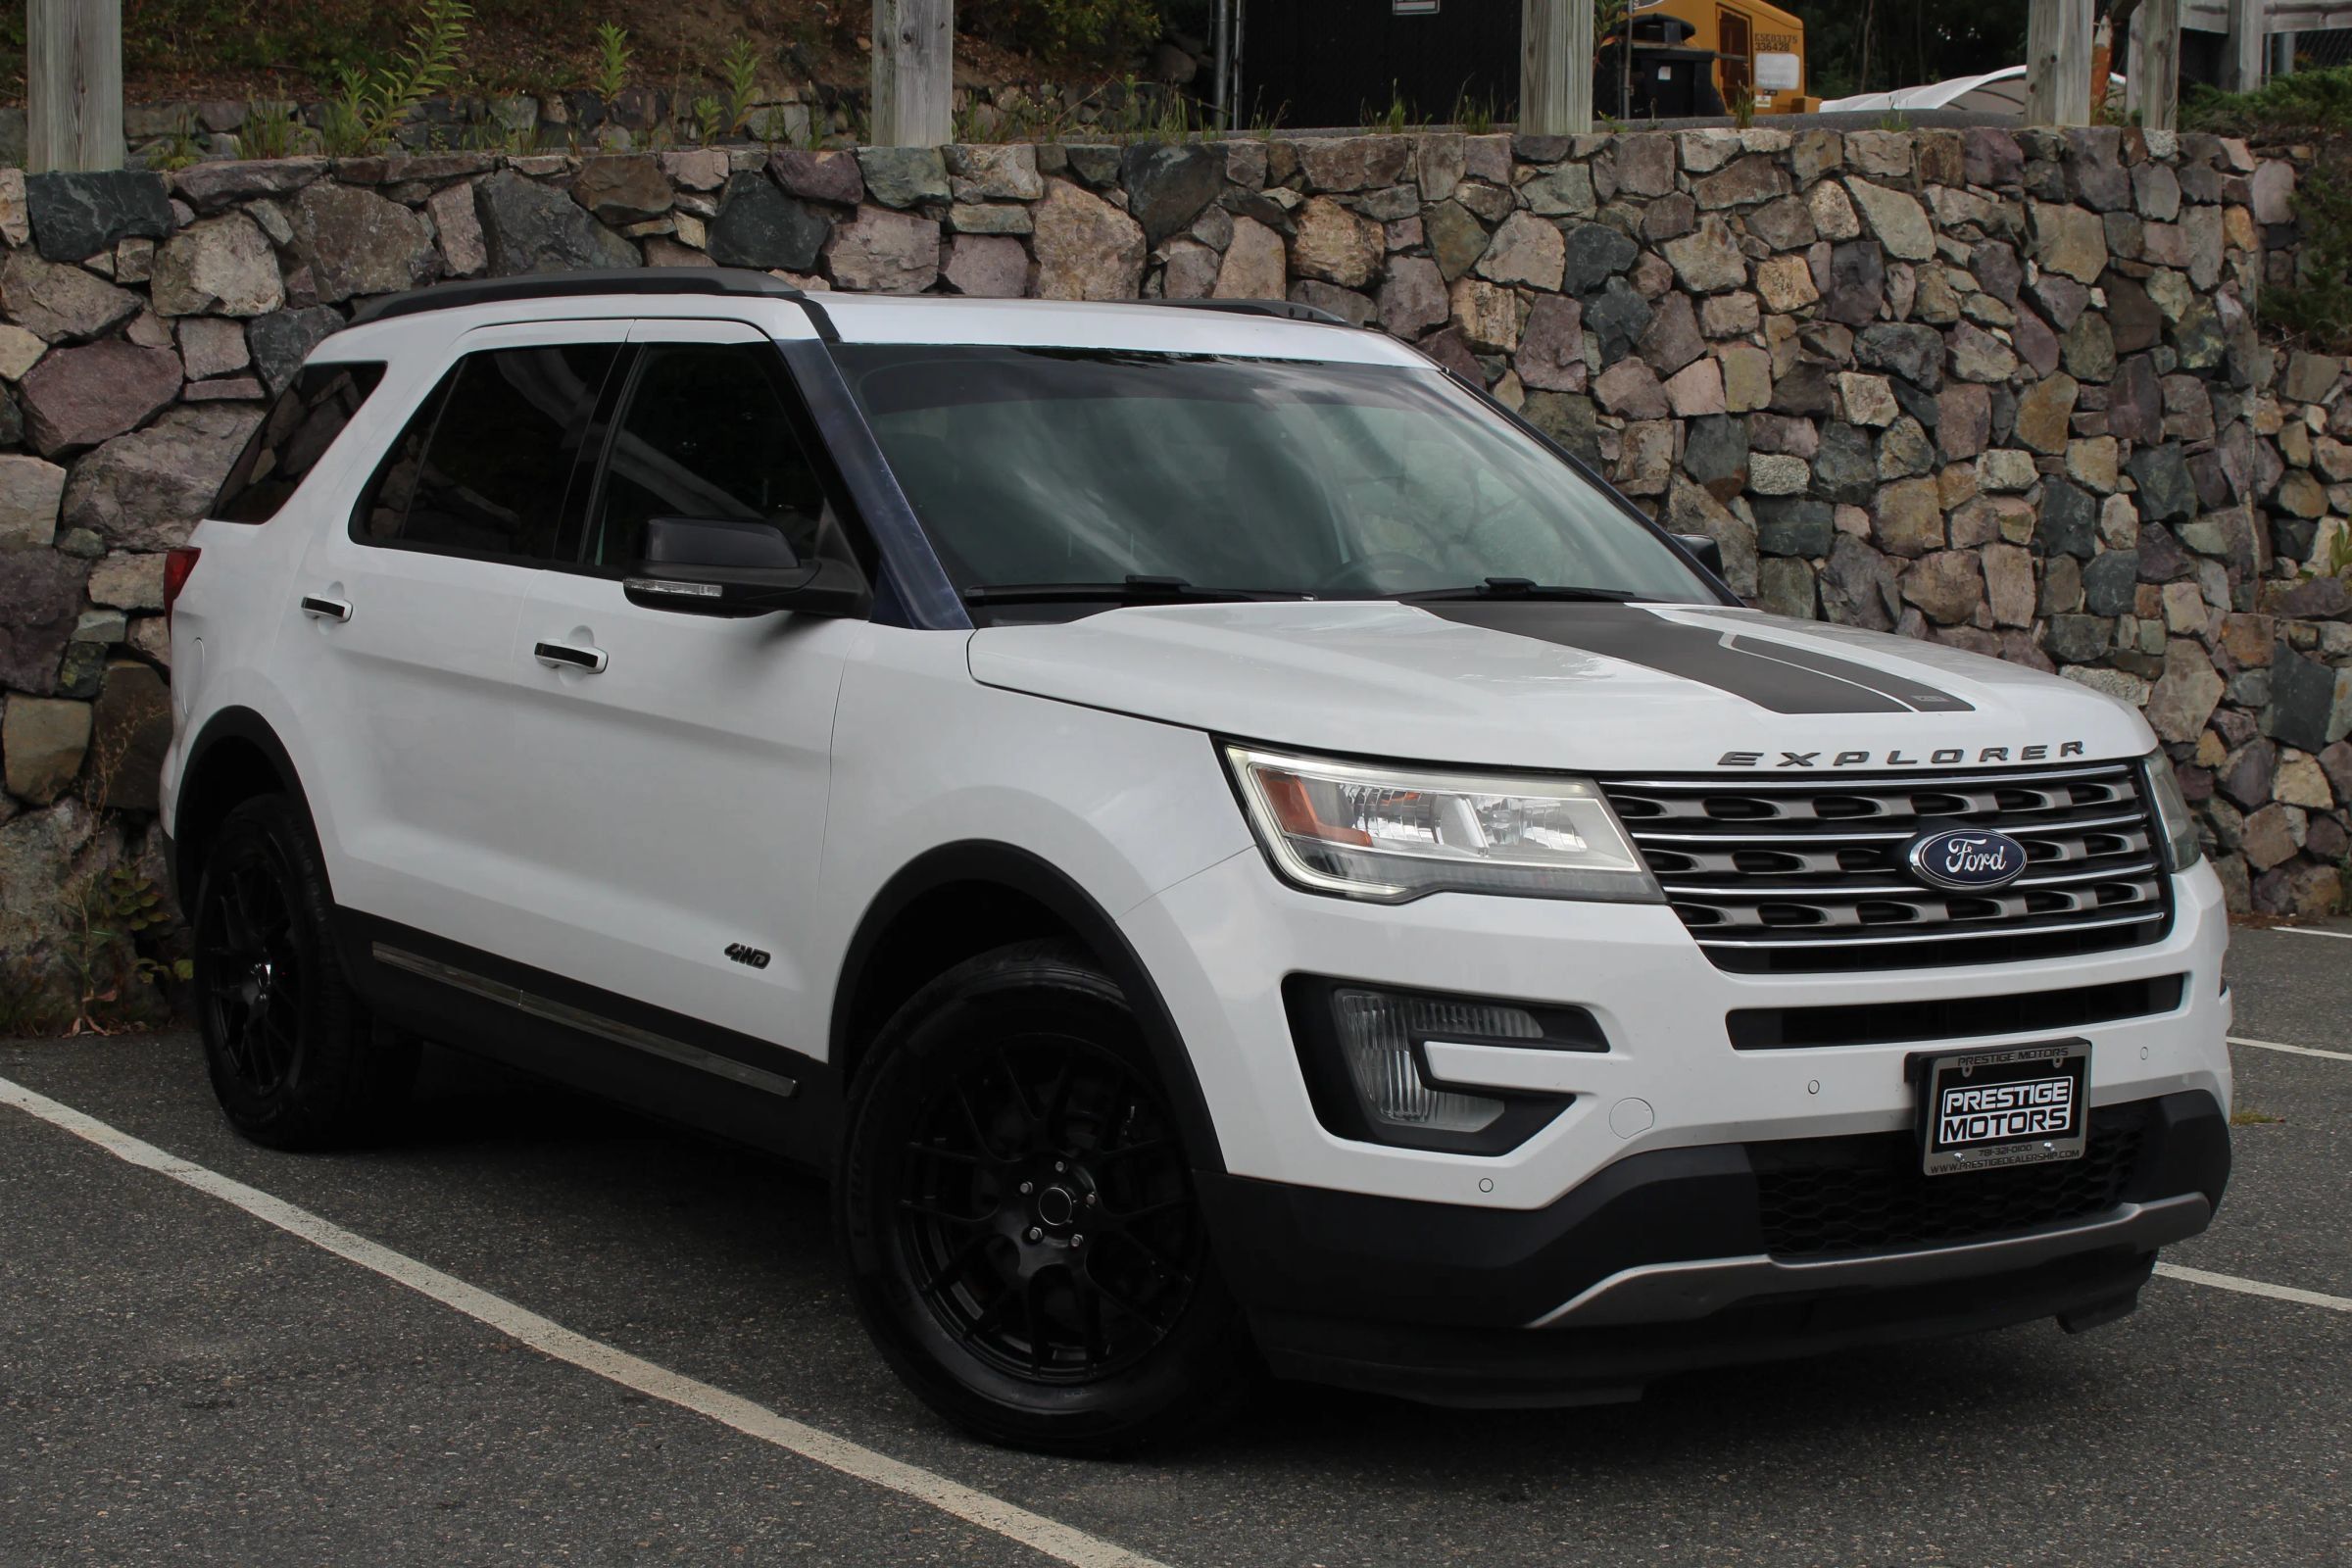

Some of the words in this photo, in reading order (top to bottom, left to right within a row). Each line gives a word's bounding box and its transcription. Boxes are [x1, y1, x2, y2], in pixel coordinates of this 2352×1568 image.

[1717, 740, 2084, 767] EXPLORER
[1944, 838, 2006, 873] Ford
[724, 942, 771, 969] 4WD
[1957, 1053, 2015, 1066] PRESTIGE
[2018, 1048, 2069, 1060] MOTORS
[1945, 1081, 2069, 1114] PRESTIGE
[1943, 1106, 2067, 1142] MOTORS
[1930, 1150, 2080, 1174] WWW.PRESTIGEDEALERSHIP.COM
[1978, 1144, 2033, 1156] 781-321-0100
